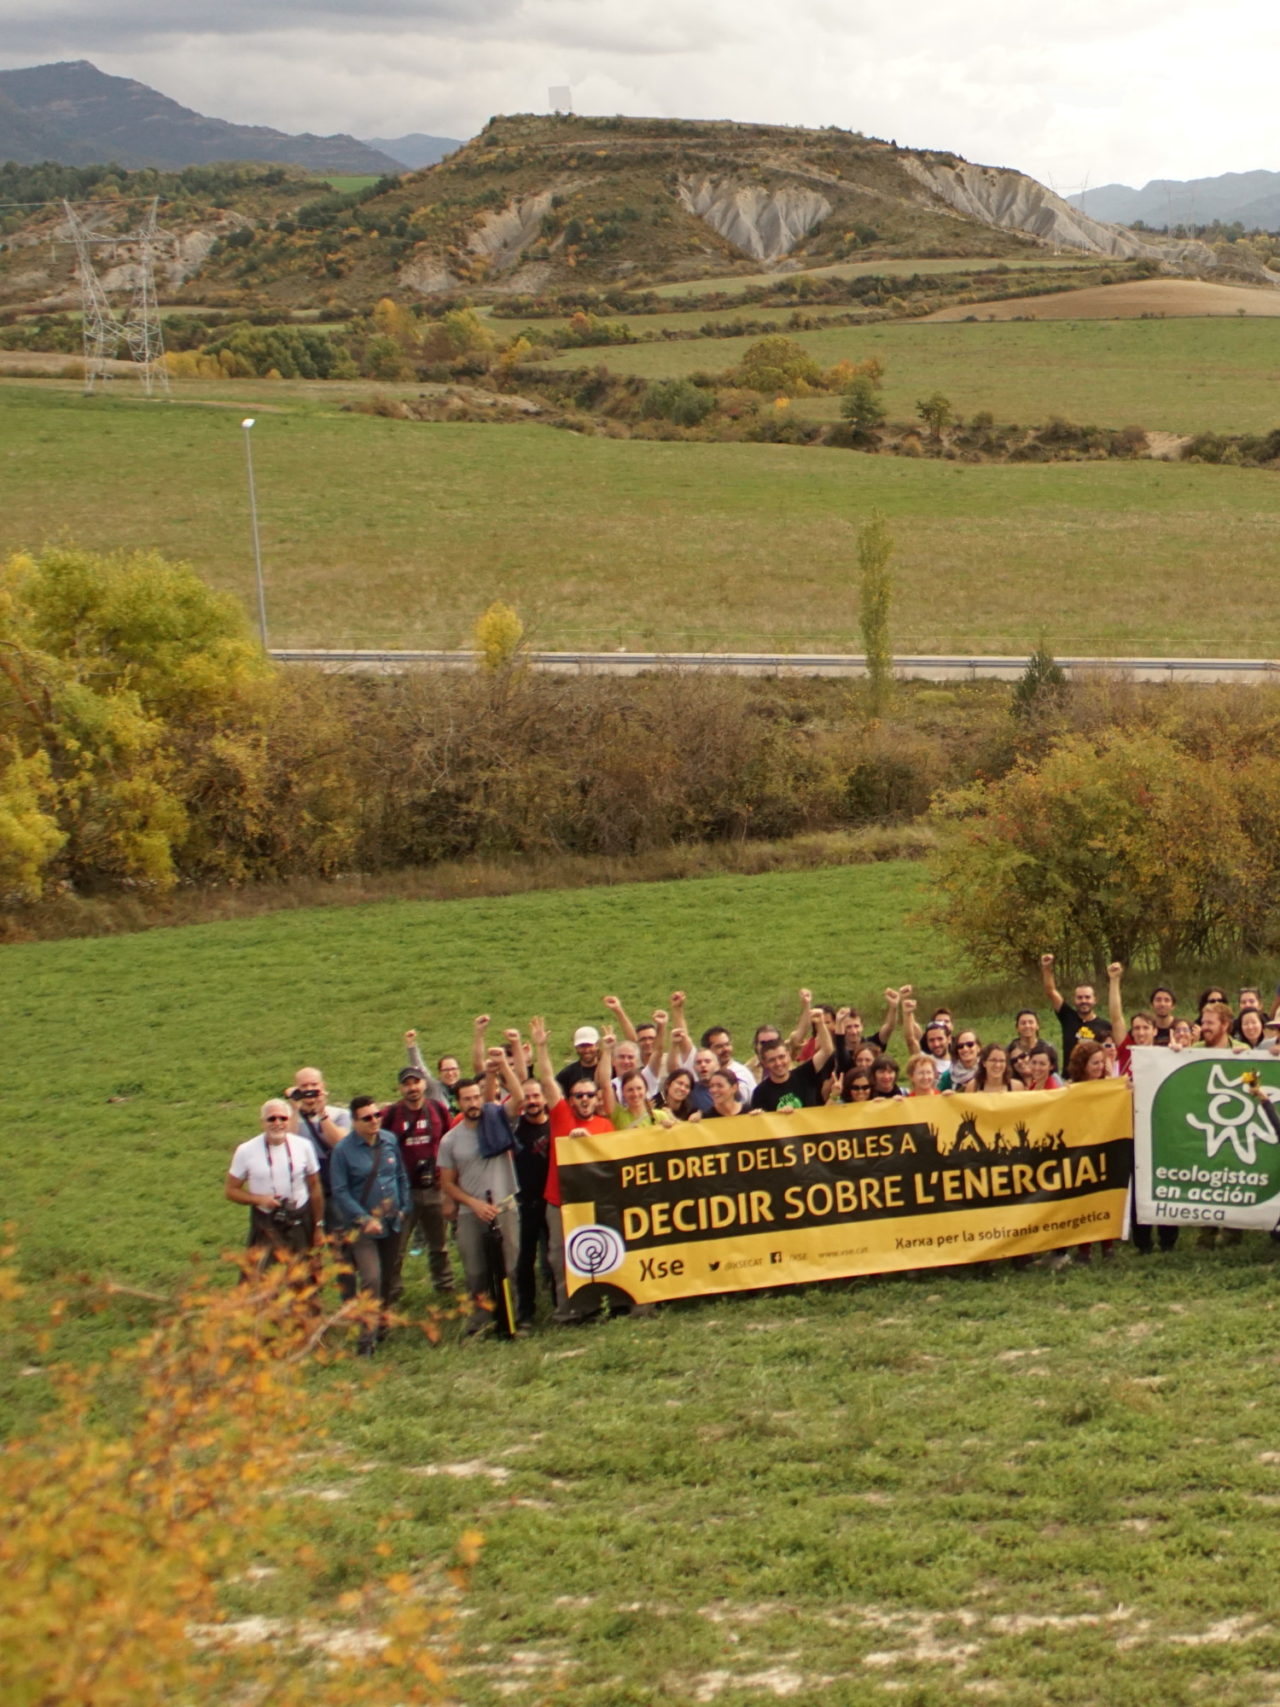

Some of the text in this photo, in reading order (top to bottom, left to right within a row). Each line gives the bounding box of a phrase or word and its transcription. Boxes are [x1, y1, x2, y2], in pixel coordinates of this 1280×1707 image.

[621, 1132, 917, 1188] PEL DRET DELS POBLES A
[1155, 1165, 1269, 1187] ecologistas
[623, 1153, 1107, 1241] DECIDIR SOBRE L'ENERGIA!
[1155, 1186, 1256, 1204] en acción
[1155, 1203, 1226, 1221] Huesca
[895, 1237, 933, 1250] Xarxa
[936, 1232, 959, 1247] per
[962, 1230, 975, 1243] la
[1042, 1209, 1111, 1230] energètica
[639, 1257, 685, 1282] Xse
